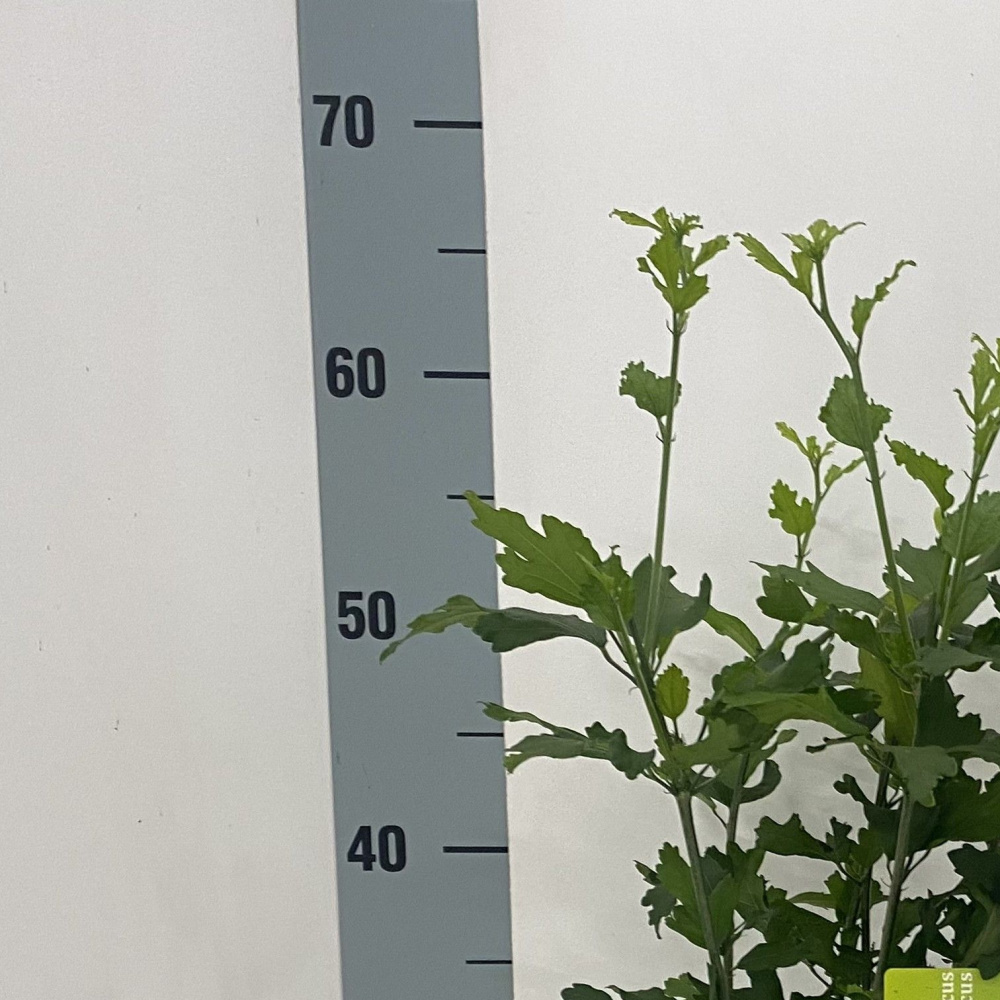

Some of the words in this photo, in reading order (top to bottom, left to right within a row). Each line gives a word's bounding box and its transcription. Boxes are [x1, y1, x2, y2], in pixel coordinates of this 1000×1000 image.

[312, 94, 375, 149] 70
[325, 346, 386, 399] 60
[337, 590, 397, 641] 50
[347, 824, 407, 873] 40
